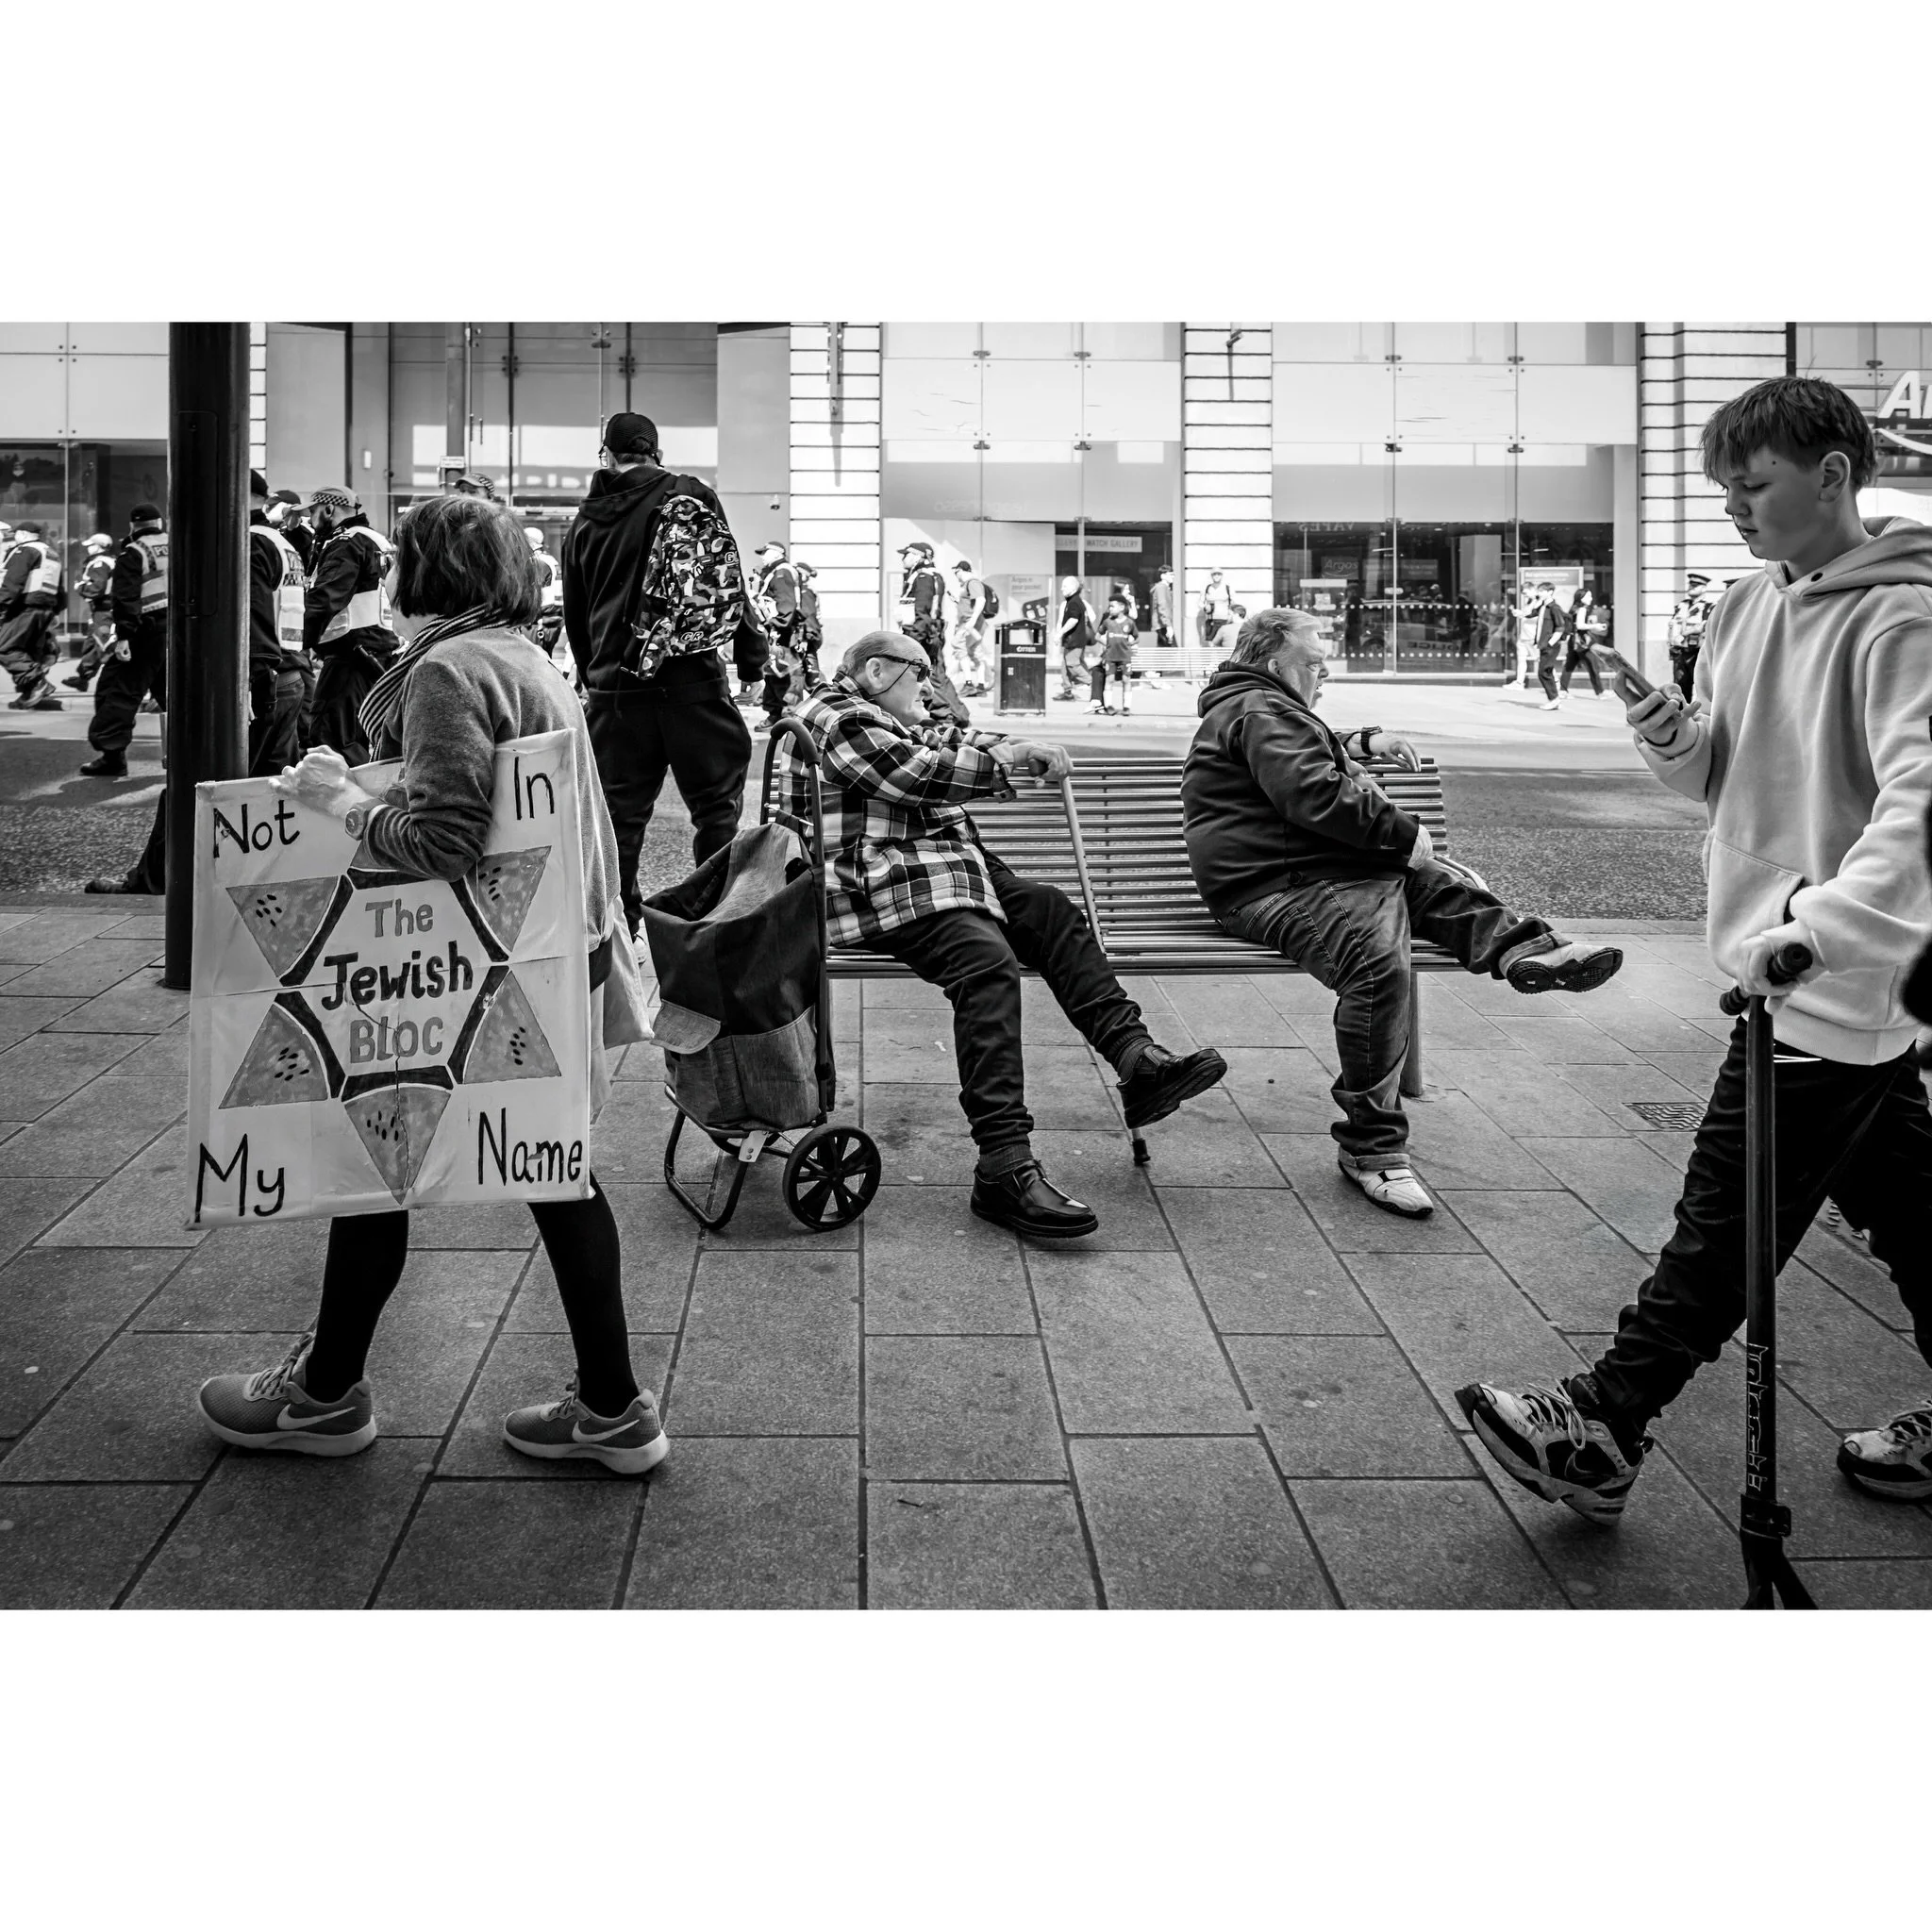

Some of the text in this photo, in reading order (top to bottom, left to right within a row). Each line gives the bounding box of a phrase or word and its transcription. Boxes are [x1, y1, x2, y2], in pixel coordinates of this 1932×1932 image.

[1086, 539, 1108, 548] WATCH
[1110, 539, 1139, 549] GALLERY
[1324, 558, 1358, 572] Argos
[213, 757, 555, 858] Not In
[365, 899, 434, 938] The
[322, 941, 473, 1010] Jewish
[193, 1108, 582, 1224] My Name
